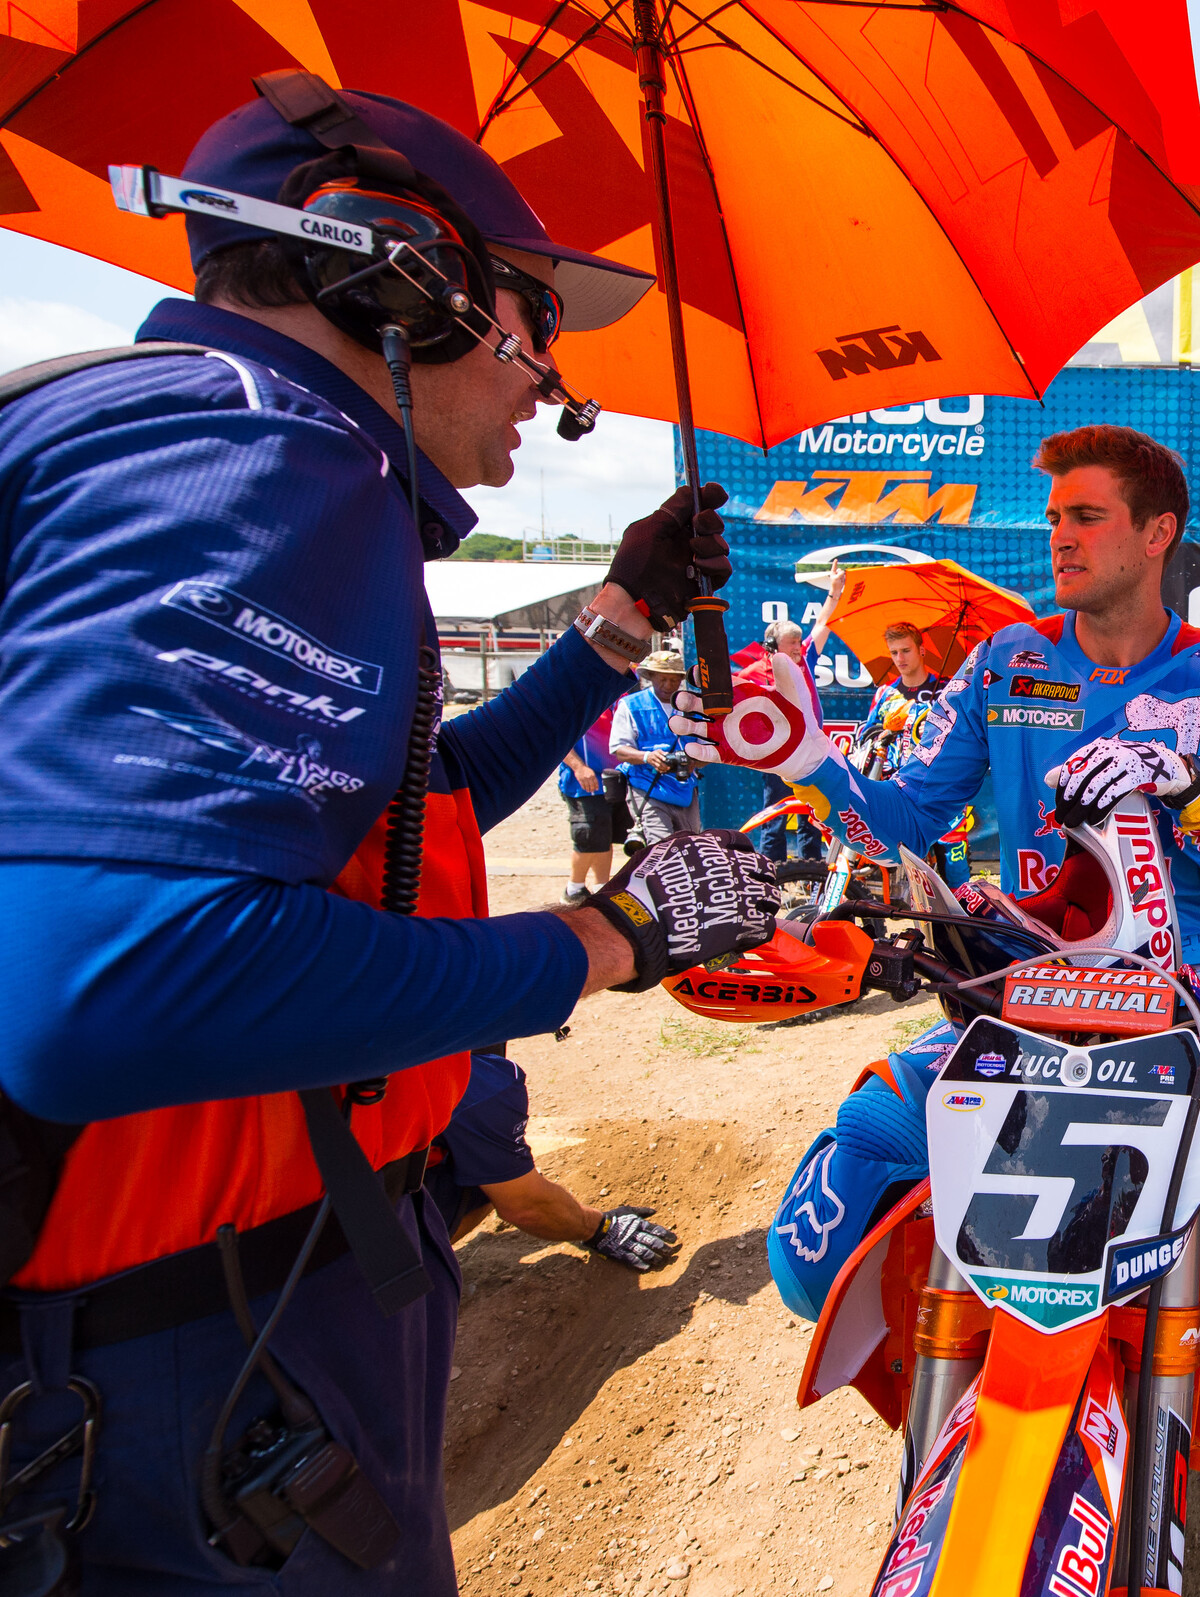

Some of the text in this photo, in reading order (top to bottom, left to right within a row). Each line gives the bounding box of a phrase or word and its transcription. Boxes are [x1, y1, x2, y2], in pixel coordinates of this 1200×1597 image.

[300, 218, 362, 246] CARLOS
[799, 425, 986, 462] Motorcycle
[754, 470, 978, 525] KTM
[233, 607, 364, 684] MOTOREX
[1008, 662, 1050, 671] RENTHAL
[1089, 668, 1131, 685] FOX
[1003, 708, 1076, 727] MOTOREX
[672, 977, 817, 1004] ACERBIS
[1010, 967, 1170, 988] RENTHAL
[1008, 985, 1168, 1015] RENTHAL
[1010, 1054, 1136, 1083] LUC OIL
[955, 1090, 1173, 1275] 5
[1116, 1240, 1186, 1286] DUNGE
[1011, 1285, 1094, 1307] MOTOREX
